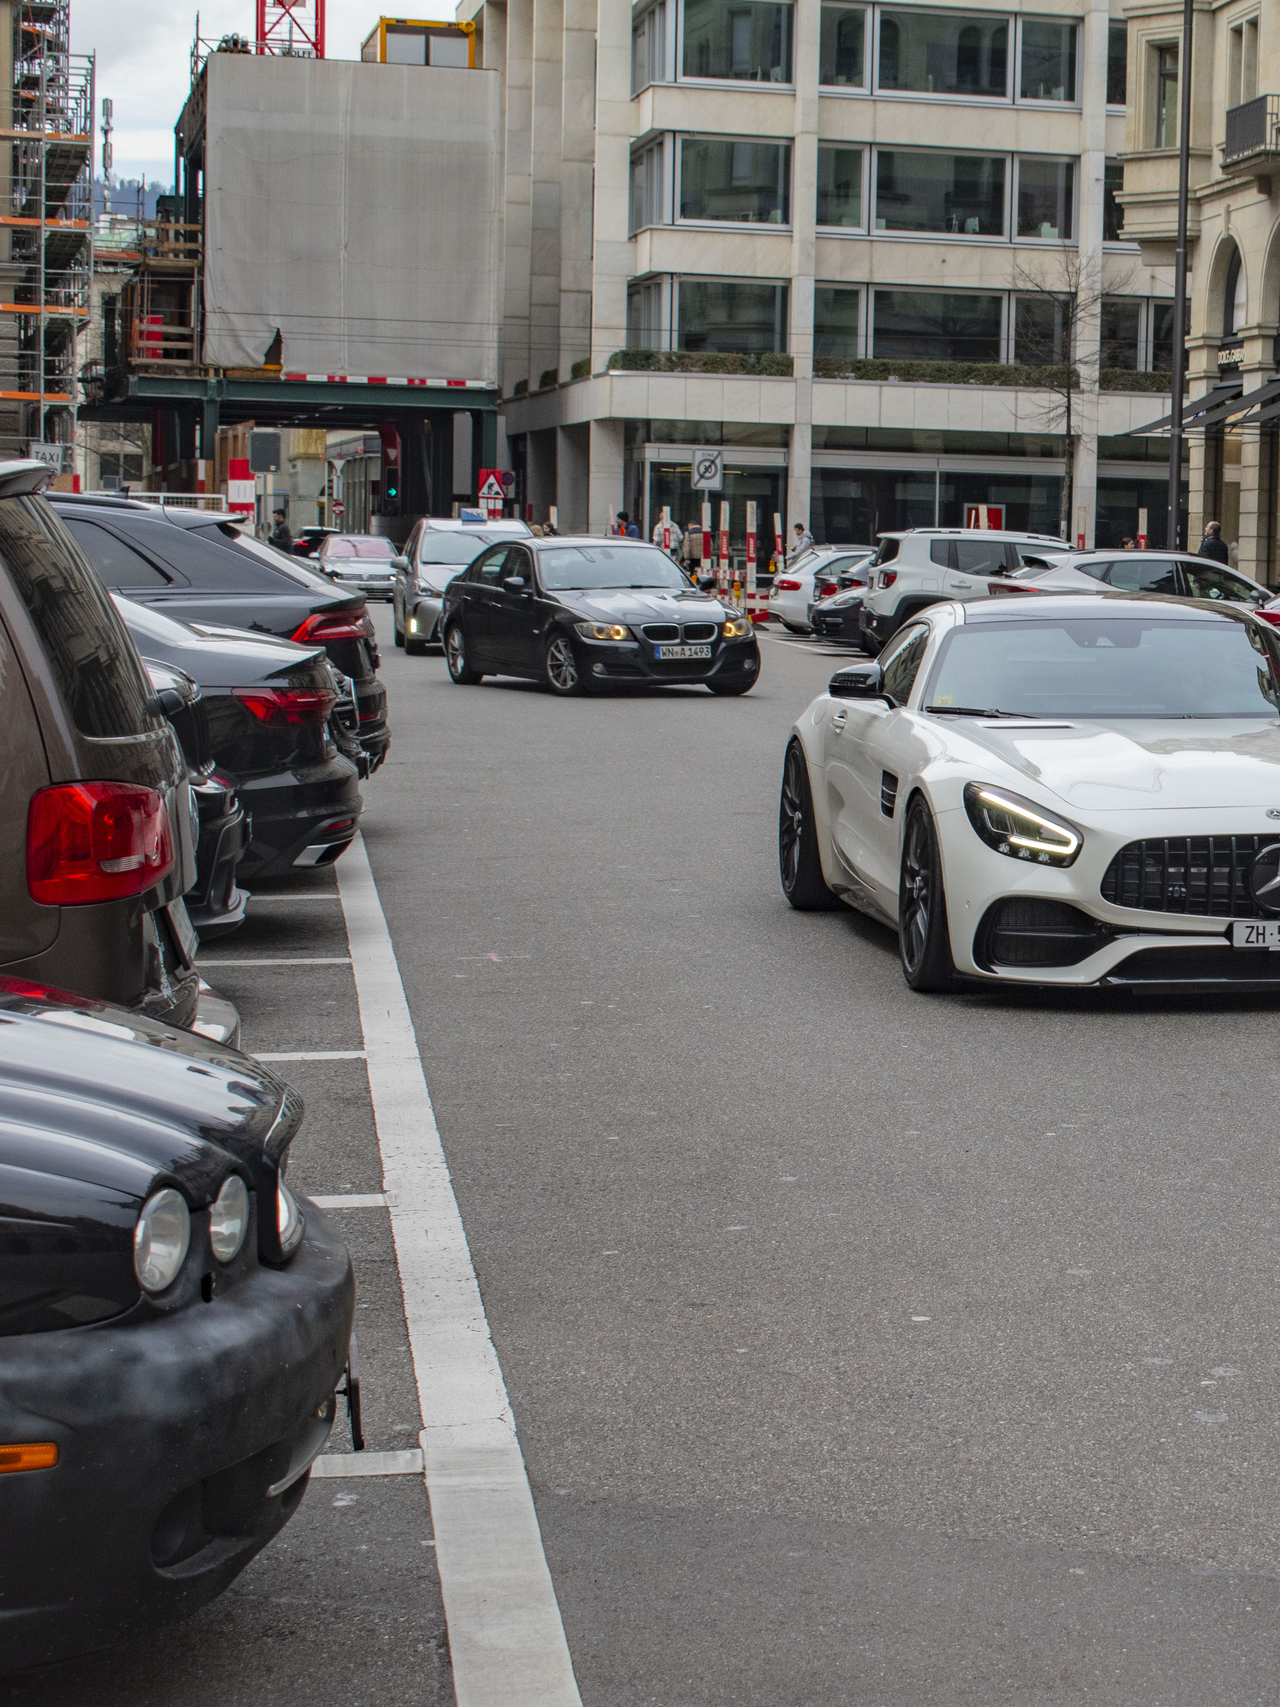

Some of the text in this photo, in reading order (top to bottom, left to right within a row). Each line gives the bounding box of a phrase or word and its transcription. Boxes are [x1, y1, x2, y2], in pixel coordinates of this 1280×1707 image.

[35, 451, 60, 463] TAXI
[702, 464, 712, 474] 30
[661, 648, 675, 658] WN
